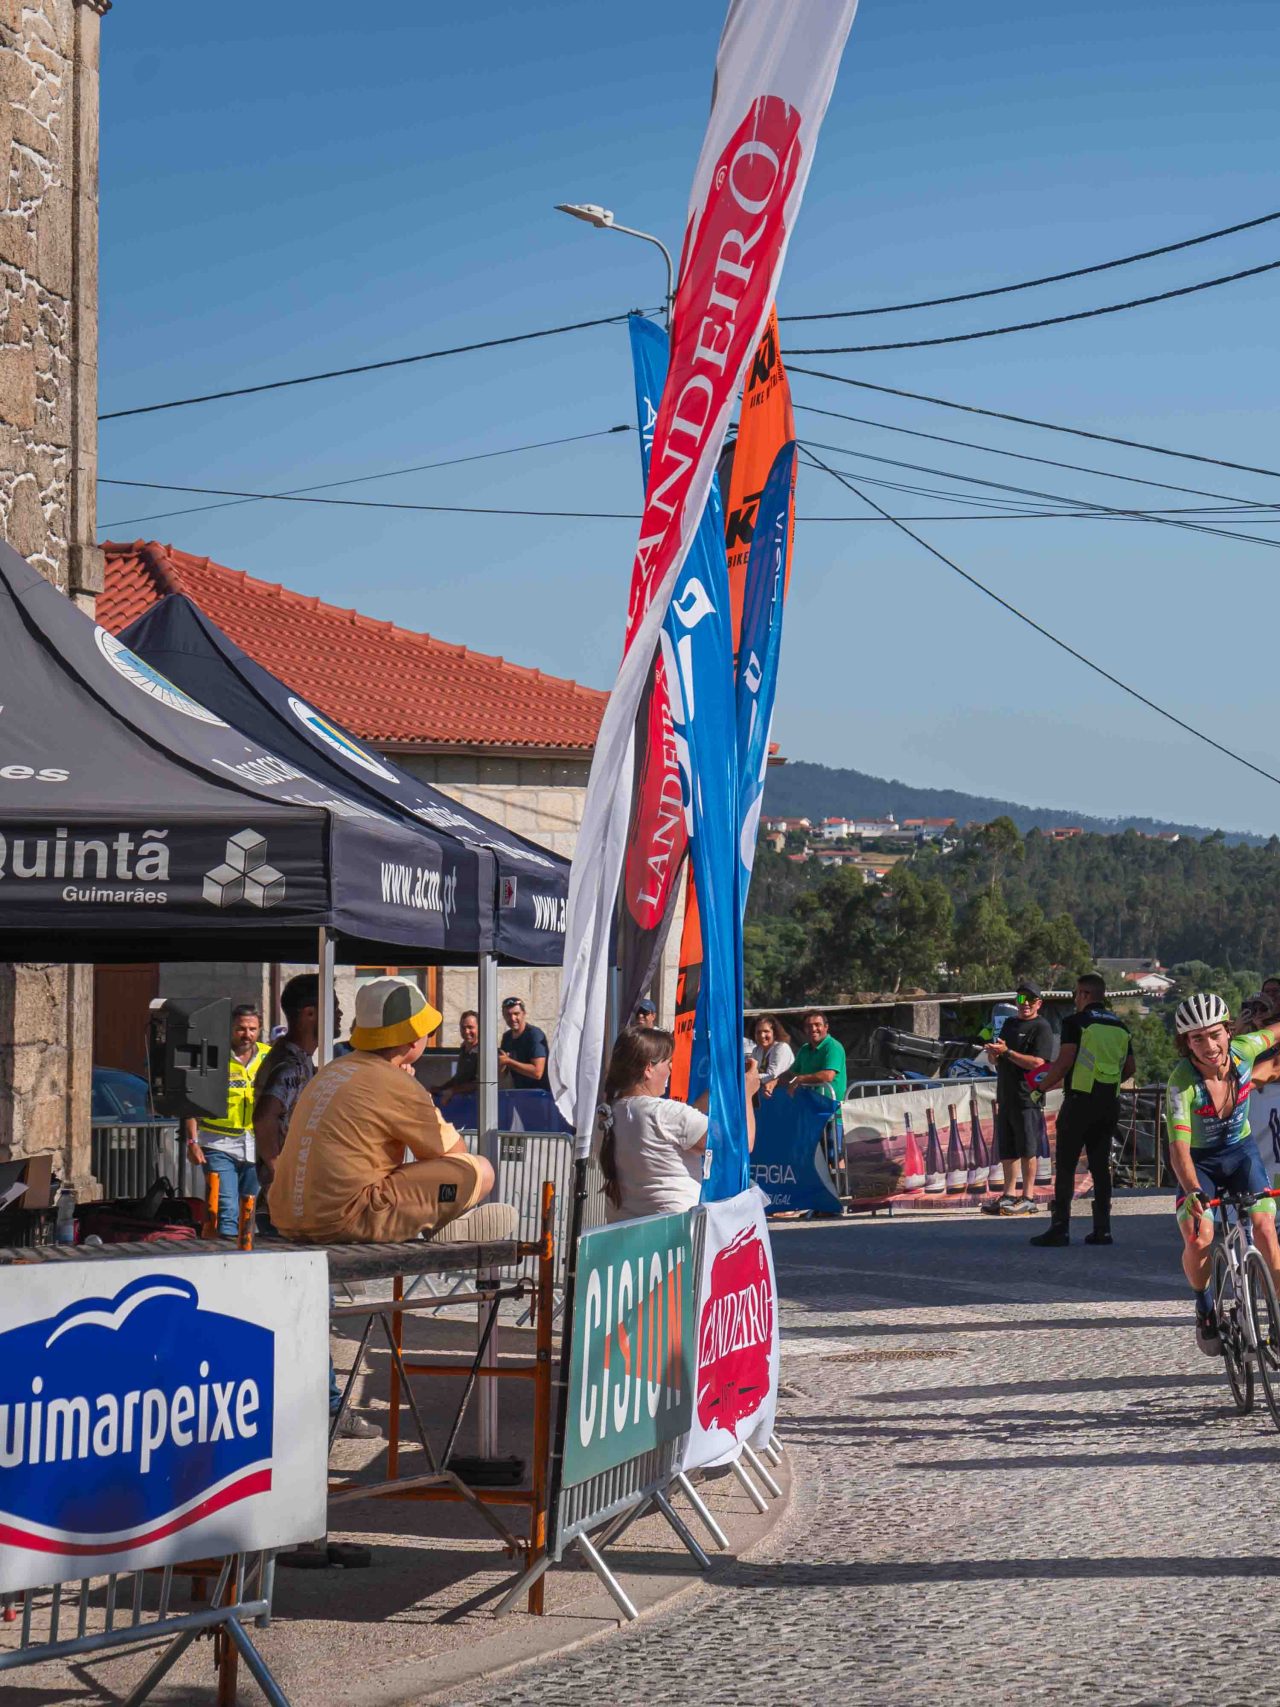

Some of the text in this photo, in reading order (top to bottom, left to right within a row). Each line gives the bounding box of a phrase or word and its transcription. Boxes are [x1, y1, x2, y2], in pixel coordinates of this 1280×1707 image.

[636, 662, 685, 911] LANDEIR
[0, 827, 170, 881] uintã
[62, 886, 168, 904] Guimarães
[381, 862, 457, 930] www.acm.pt
[533, 894, 568, 933] www.a
[579, 1246, 682, 1448] CISION
[0, 1360, 260, 1474] uimarpeixe
